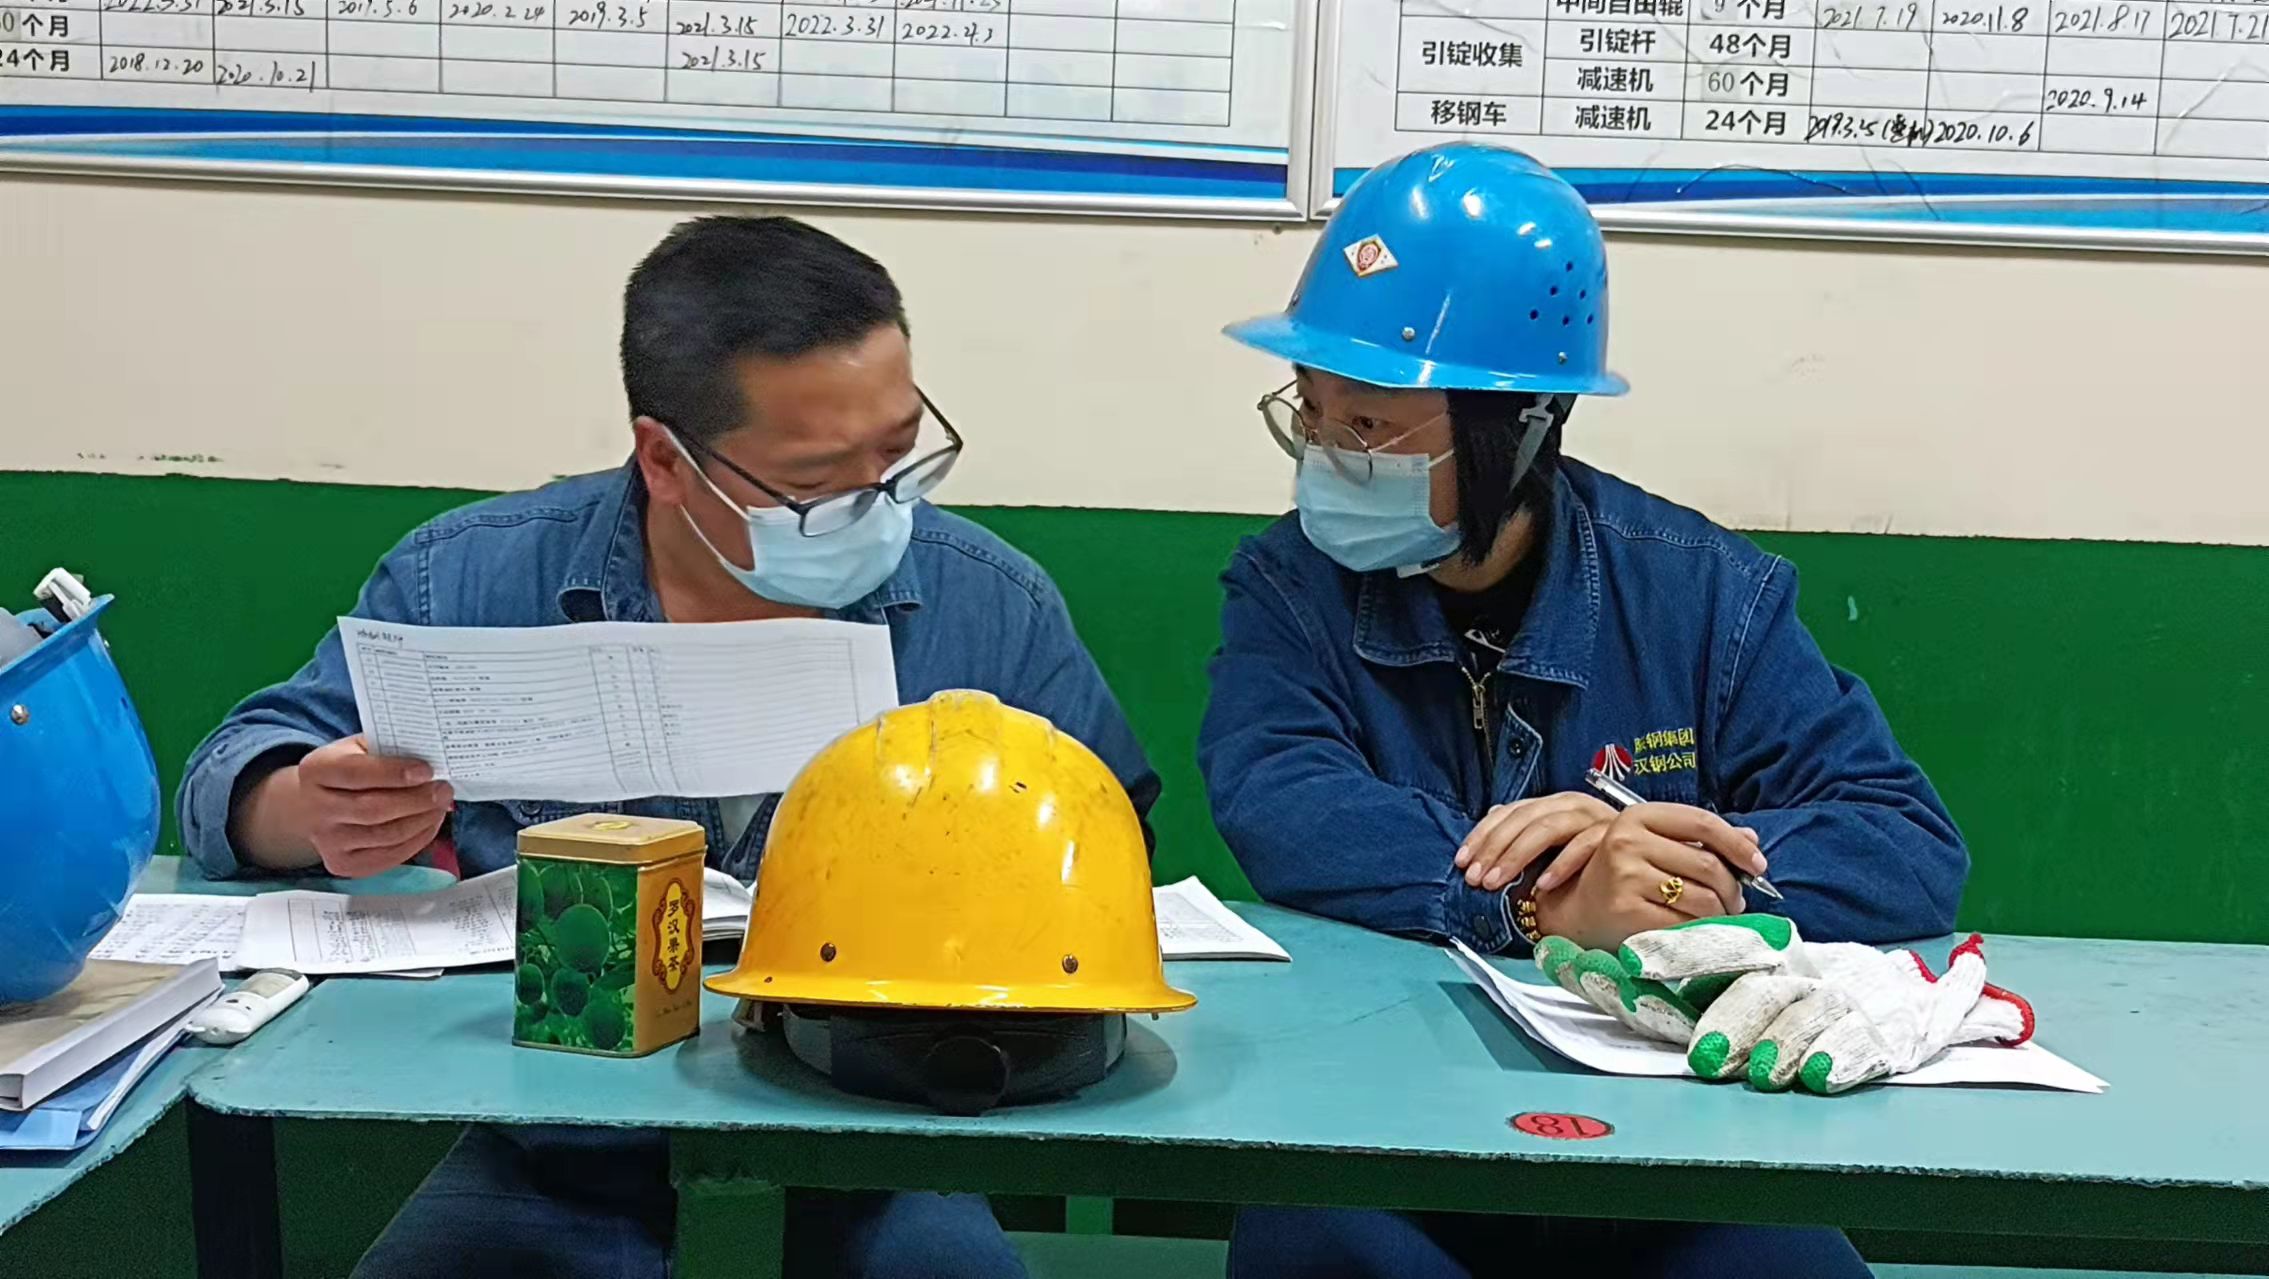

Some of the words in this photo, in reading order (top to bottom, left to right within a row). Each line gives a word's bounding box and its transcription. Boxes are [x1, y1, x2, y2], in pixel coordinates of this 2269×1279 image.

[0, 11, 69, 37] 0个月
[785, 13, 884, 39] 2022.3.31
[1422, 40, 1523, 68] 引锭收集
[1580, 28, 1656, 54] 引锭杆
[1709, 32, 1791, 59] 48个月
[109, 52, 204, 76] 2018.12.20
[1577, 66, 1654, 93] 减速机
[1707, 71, 1789, 97] 60个月
[1431, 100, 1508, 127] 移钢车
[1575, 104, 1652, 131] 减速机
[1705, 109, 1786, 136] 24个月
